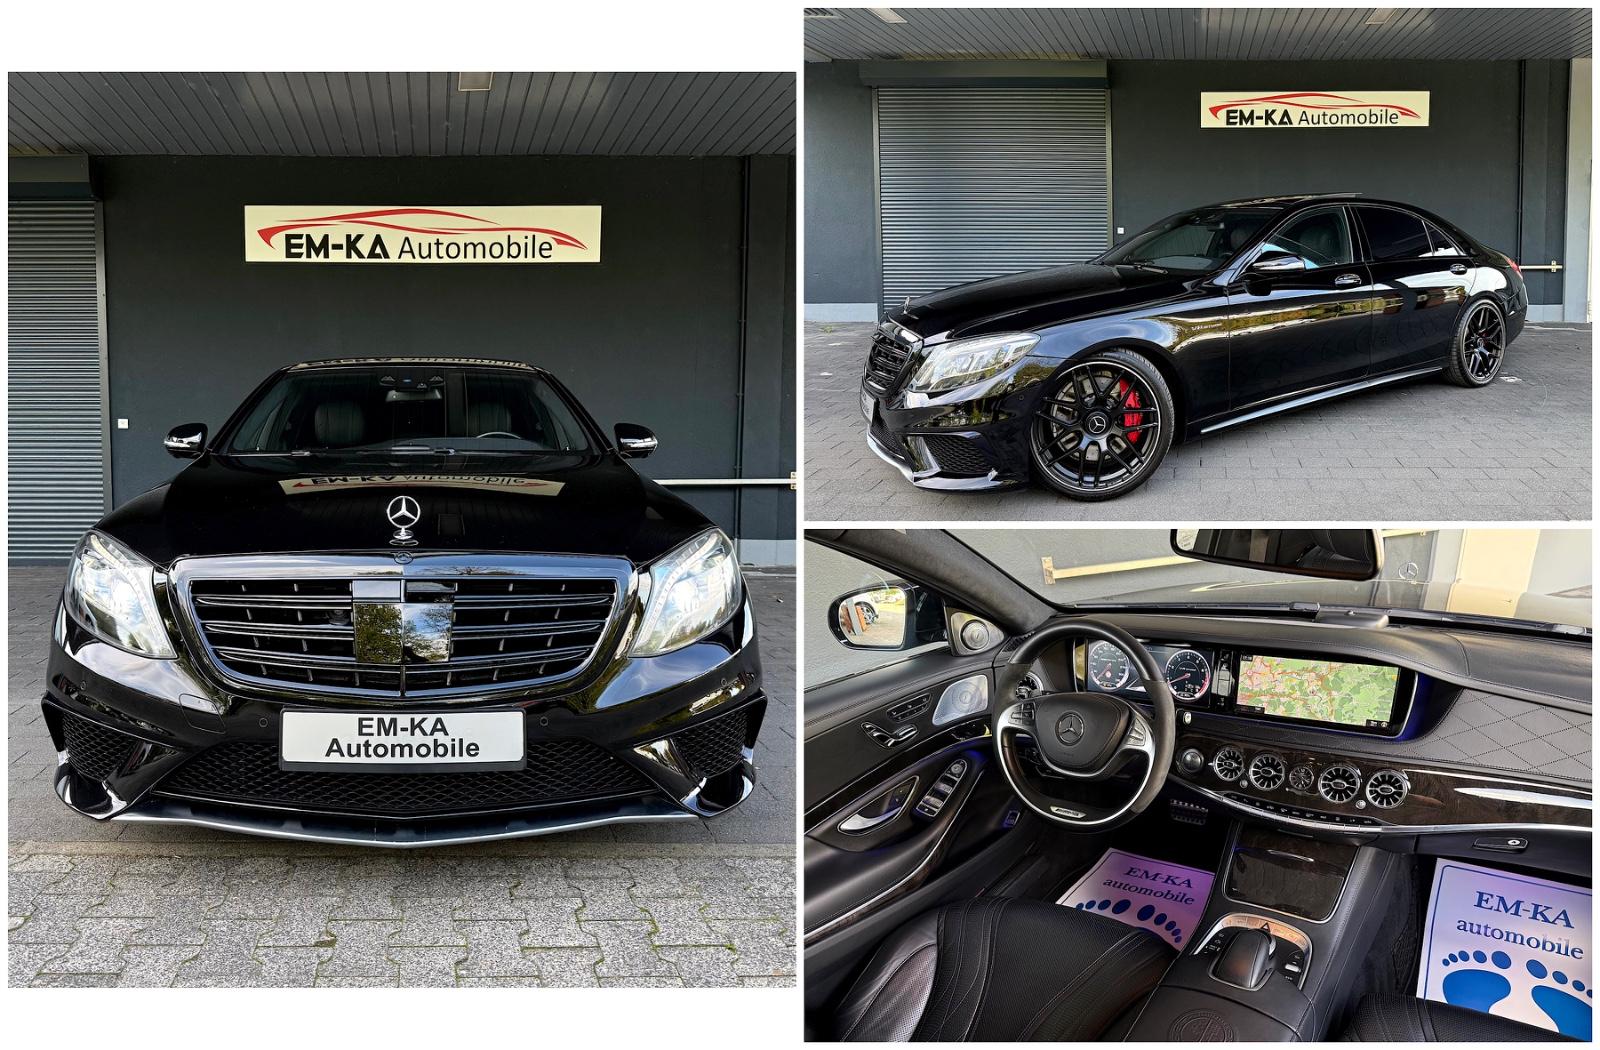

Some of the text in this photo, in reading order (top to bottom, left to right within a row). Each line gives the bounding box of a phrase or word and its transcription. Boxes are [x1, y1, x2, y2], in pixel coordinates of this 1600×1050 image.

[1226, 109, 1399, 125] EM-KA Automobile
[284, 233, 553, 259] EM-KA Automobile
[357, 717, 449, 736] EM-KA
[325, 738, 480, 758] Automobile
[1124, 867, 1193, 888] EM-KA
[1103, 879, 1195, 905] automobile
[1473, 890, 1575, 929] EM-KA
[1456, 919, 1584, 960] automobile
